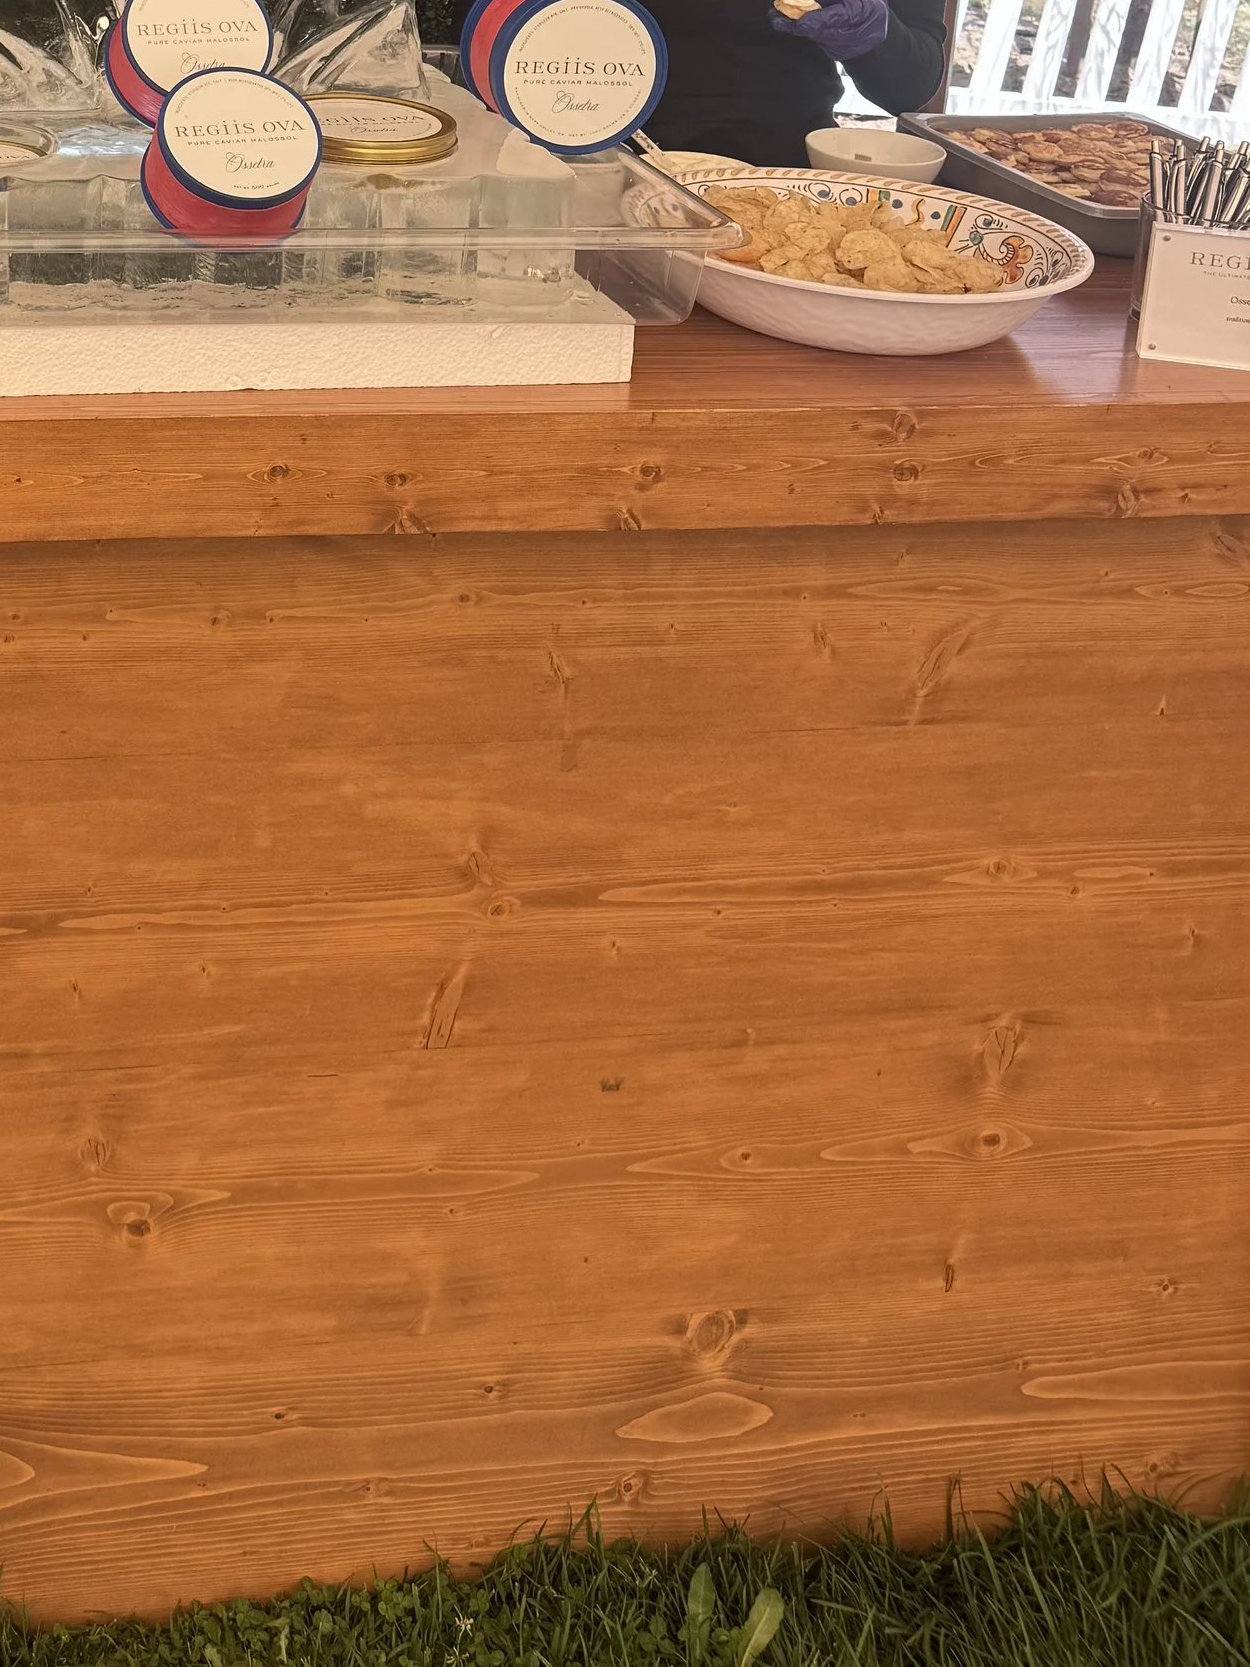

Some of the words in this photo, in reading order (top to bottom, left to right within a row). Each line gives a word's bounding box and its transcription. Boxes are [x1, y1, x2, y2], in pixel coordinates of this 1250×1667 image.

[219, 21, 258, 33] OVA
[603, 62, 645, 76] OVA
[552, 90, 600, 114] Ossetra
[262, 120, 305, 133] OVA
[225, 152, 275, 173] Ossetra
